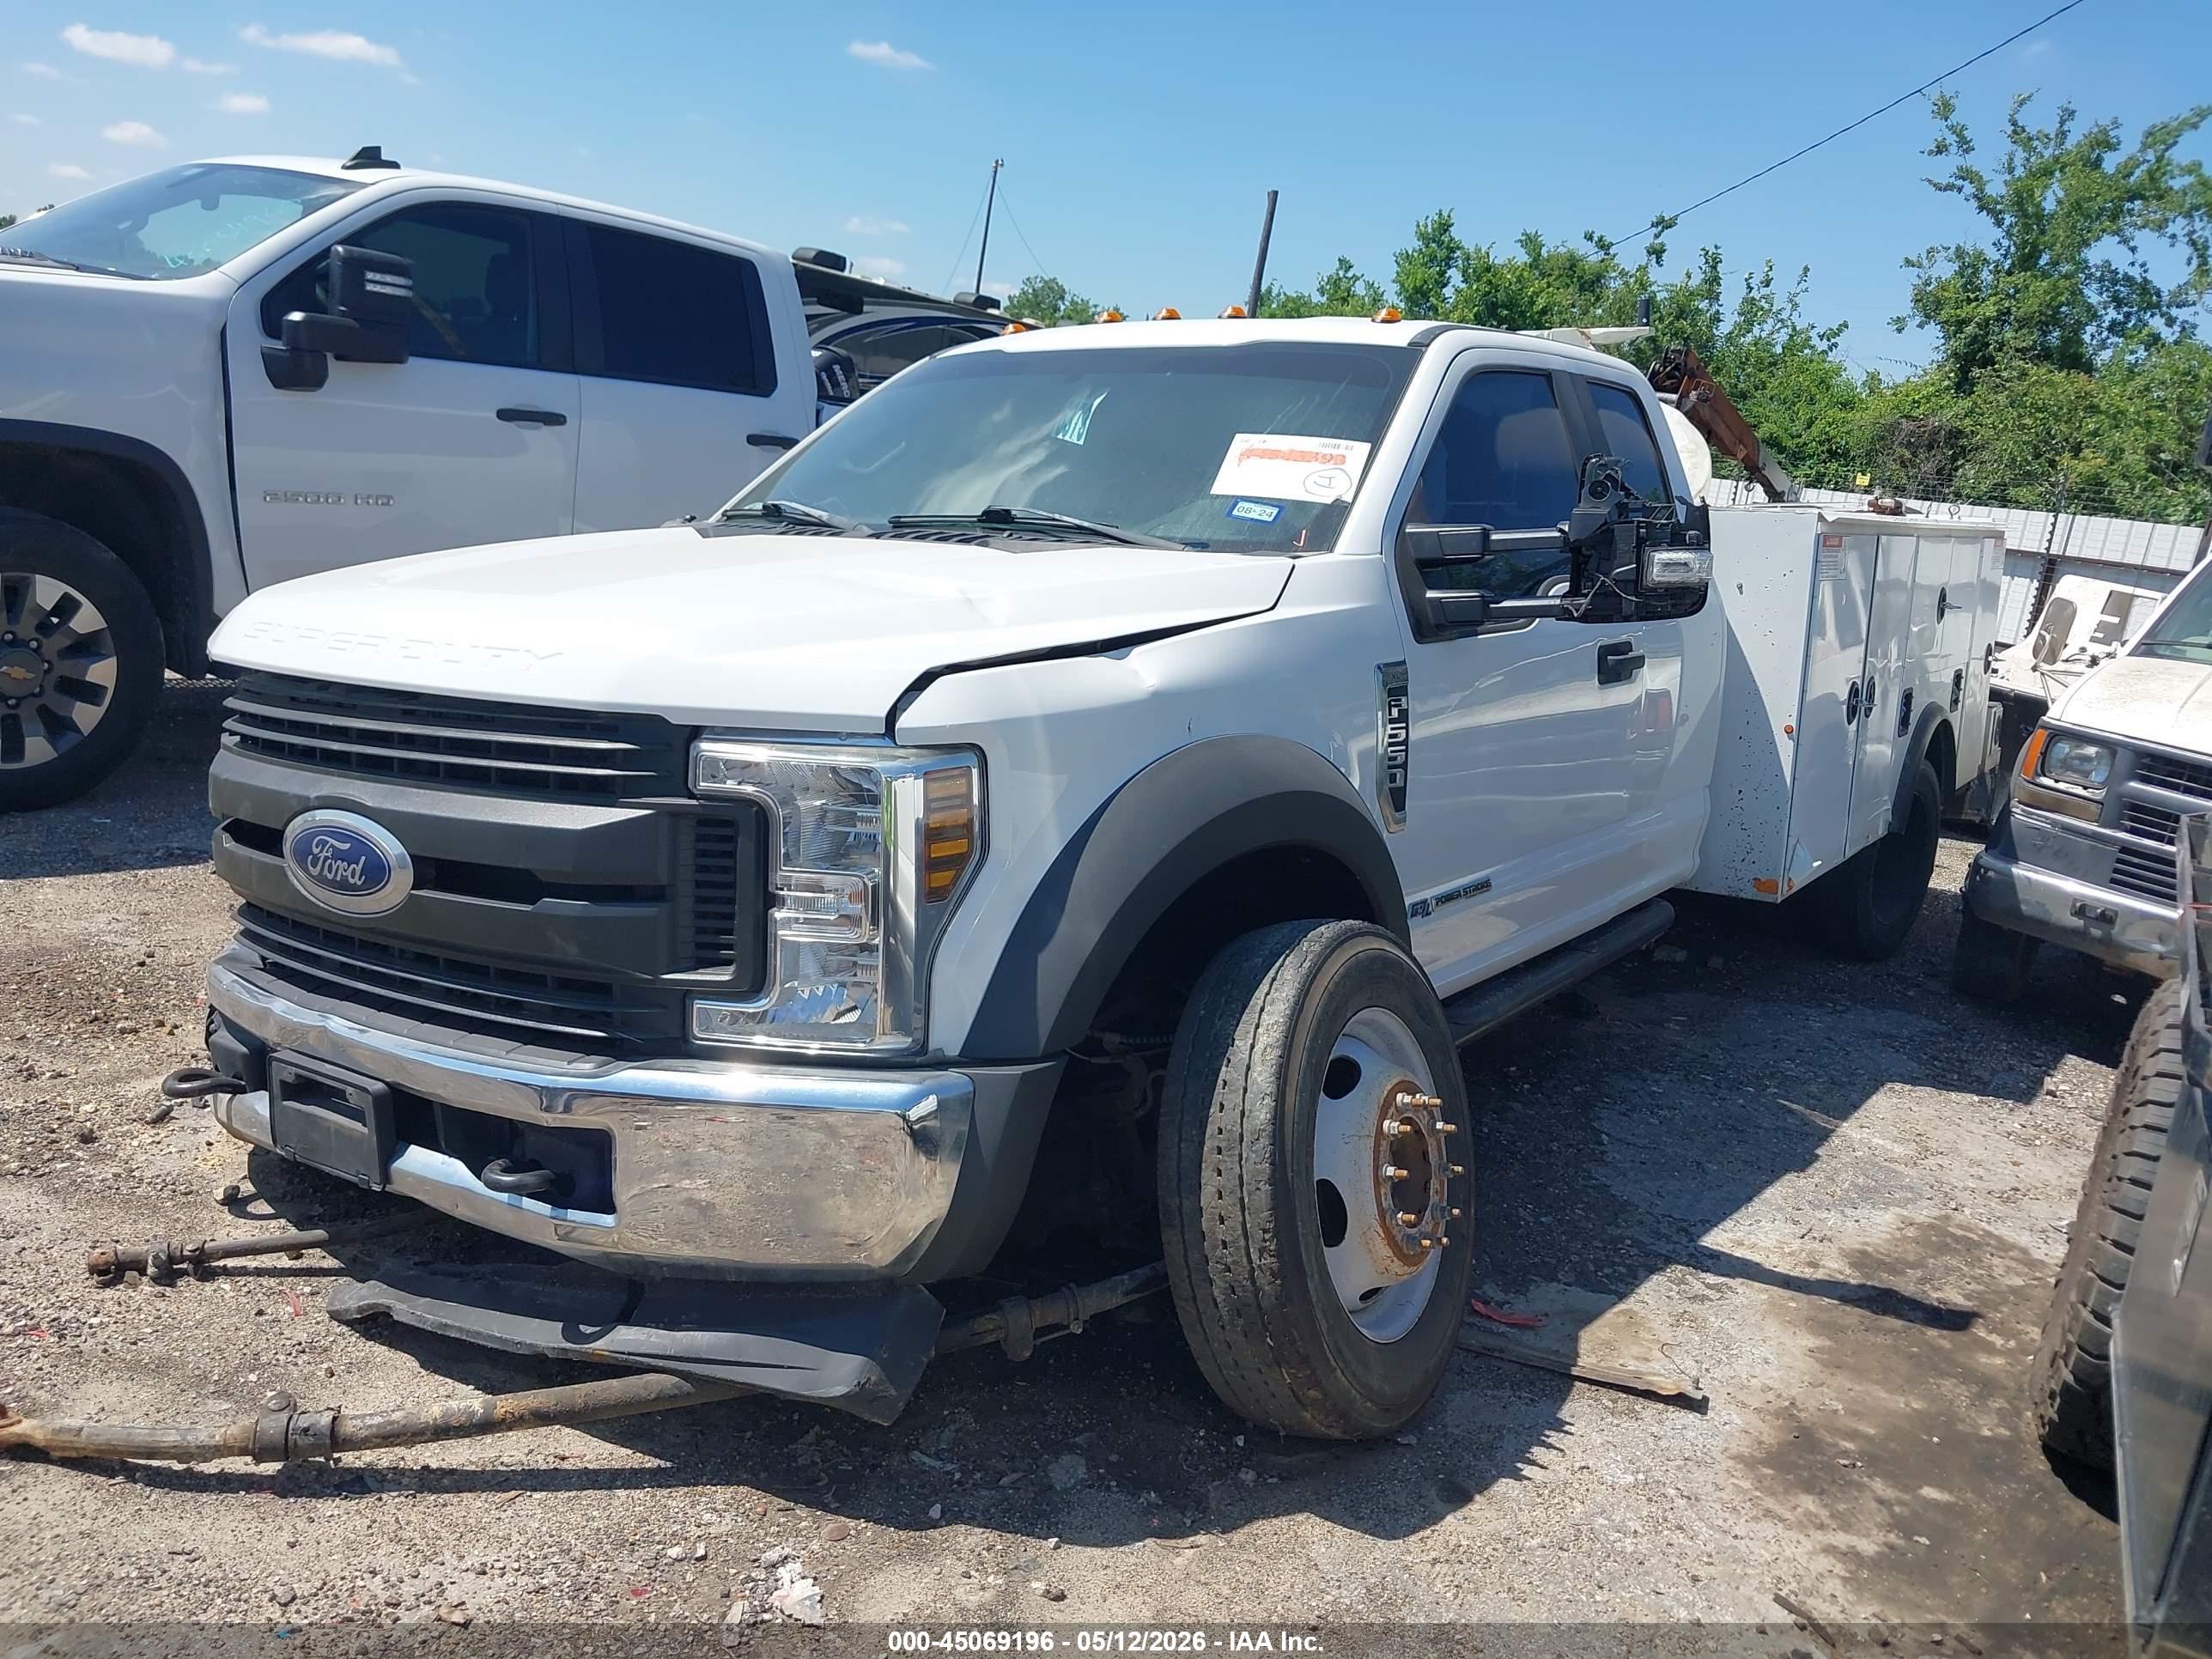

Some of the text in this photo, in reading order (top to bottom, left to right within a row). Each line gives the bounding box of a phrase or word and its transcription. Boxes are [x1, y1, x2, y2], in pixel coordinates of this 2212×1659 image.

[264, 490, 395, 507] 2500 HD
[242, 621, 565, 672] SUPER DUTY
[307, 836, 366, 885] Ford
[1435, 890, 1462, 907] POWER
[1462, 878, 1492, 896] STROKE
